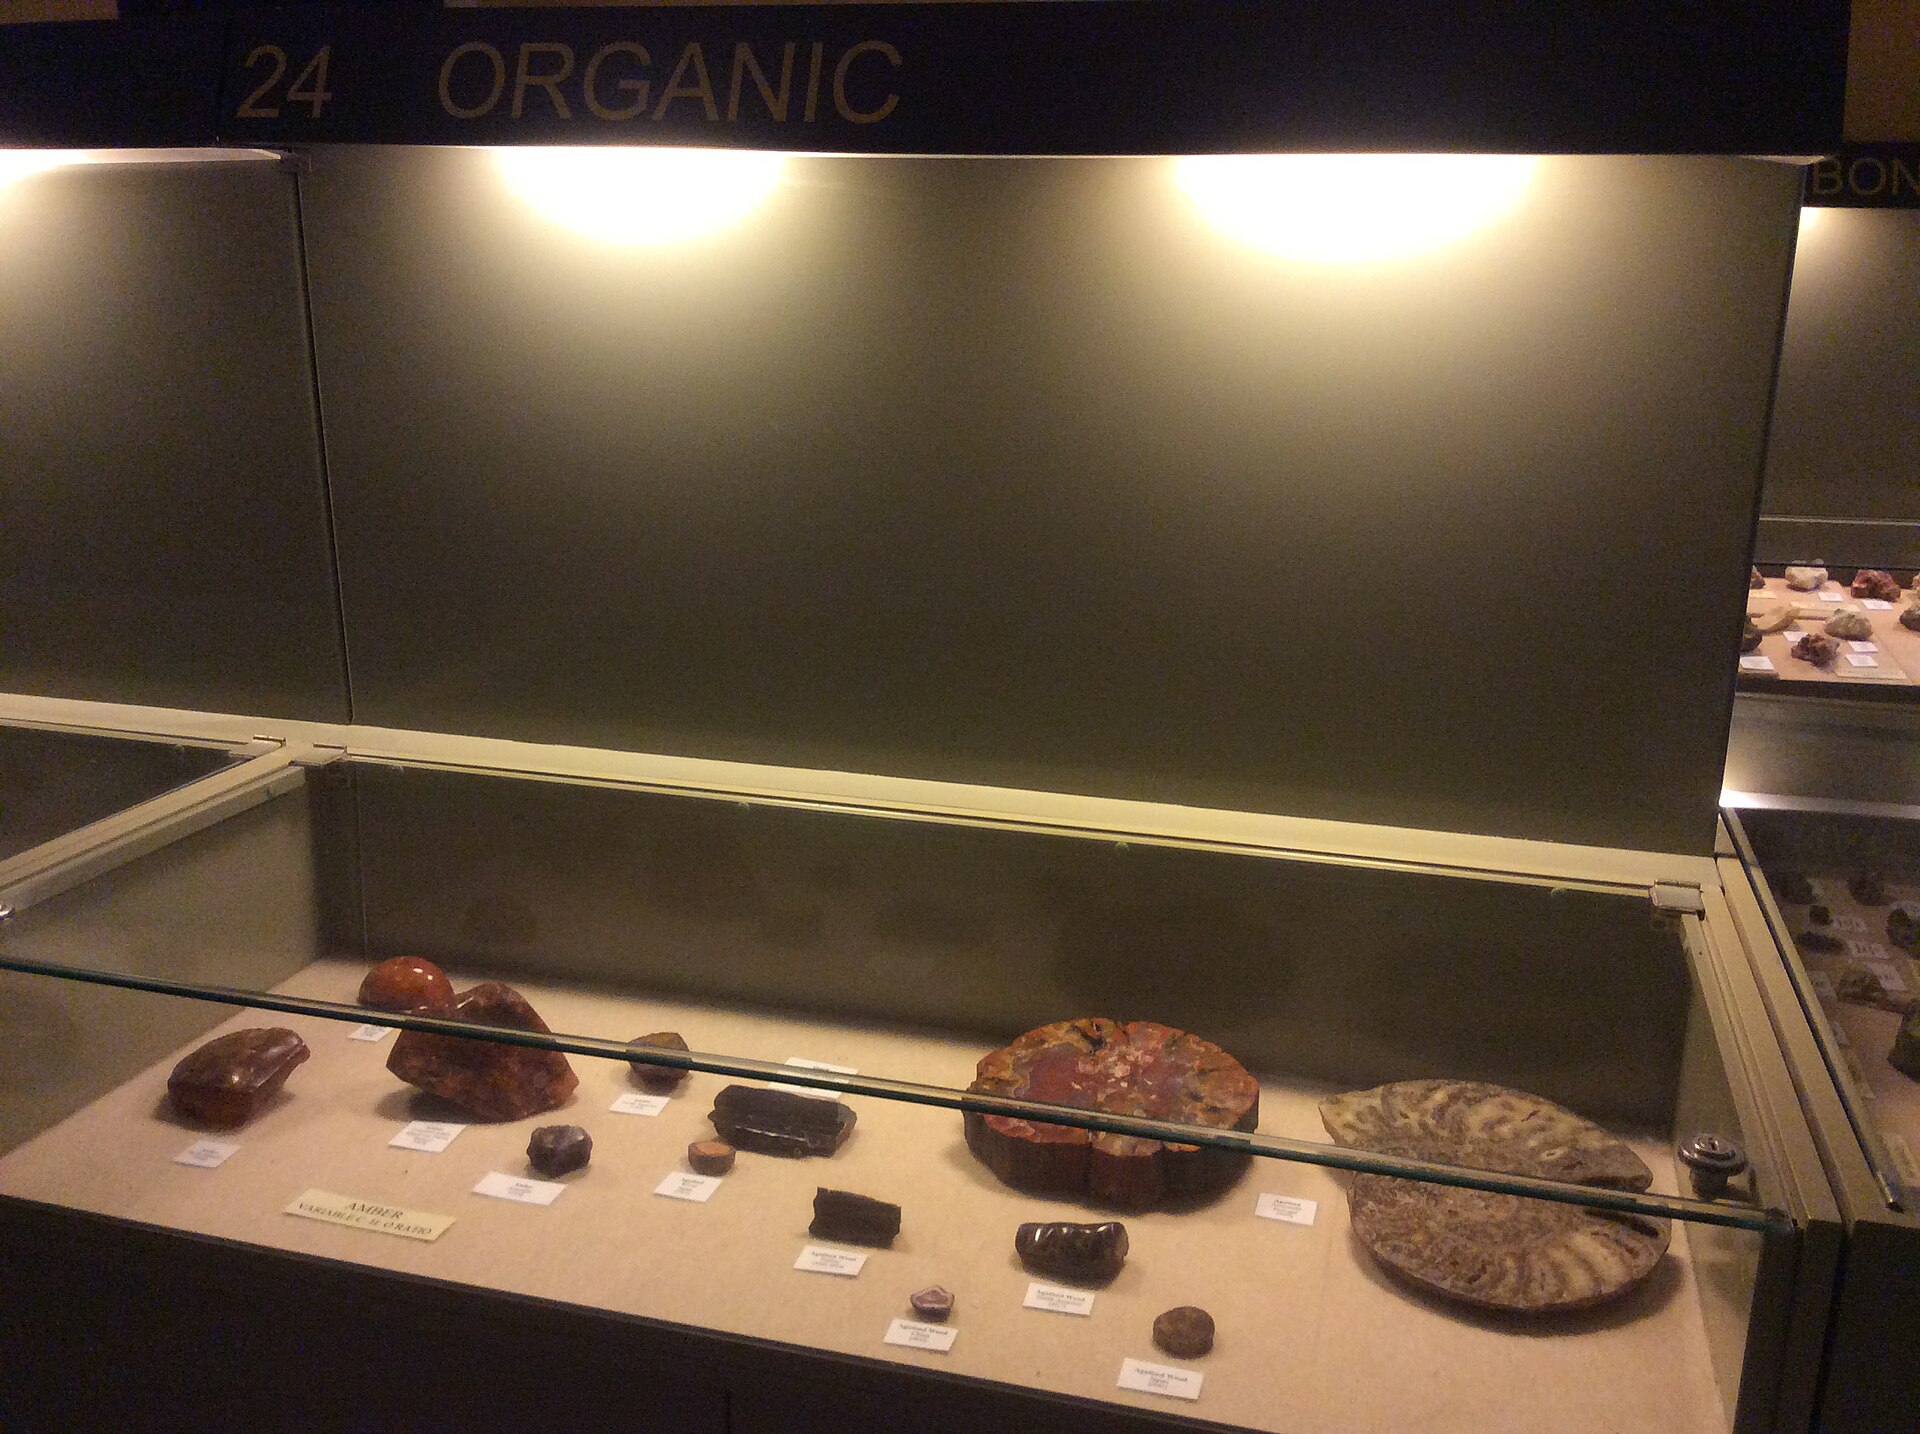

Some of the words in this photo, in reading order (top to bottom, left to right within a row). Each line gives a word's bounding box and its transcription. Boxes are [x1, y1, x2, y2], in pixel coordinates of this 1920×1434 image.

[236, 43, 332, 120] 24
[437, 40, 903, 124] ORGANIC
[346, 1202, 404, 1219] AMBER
